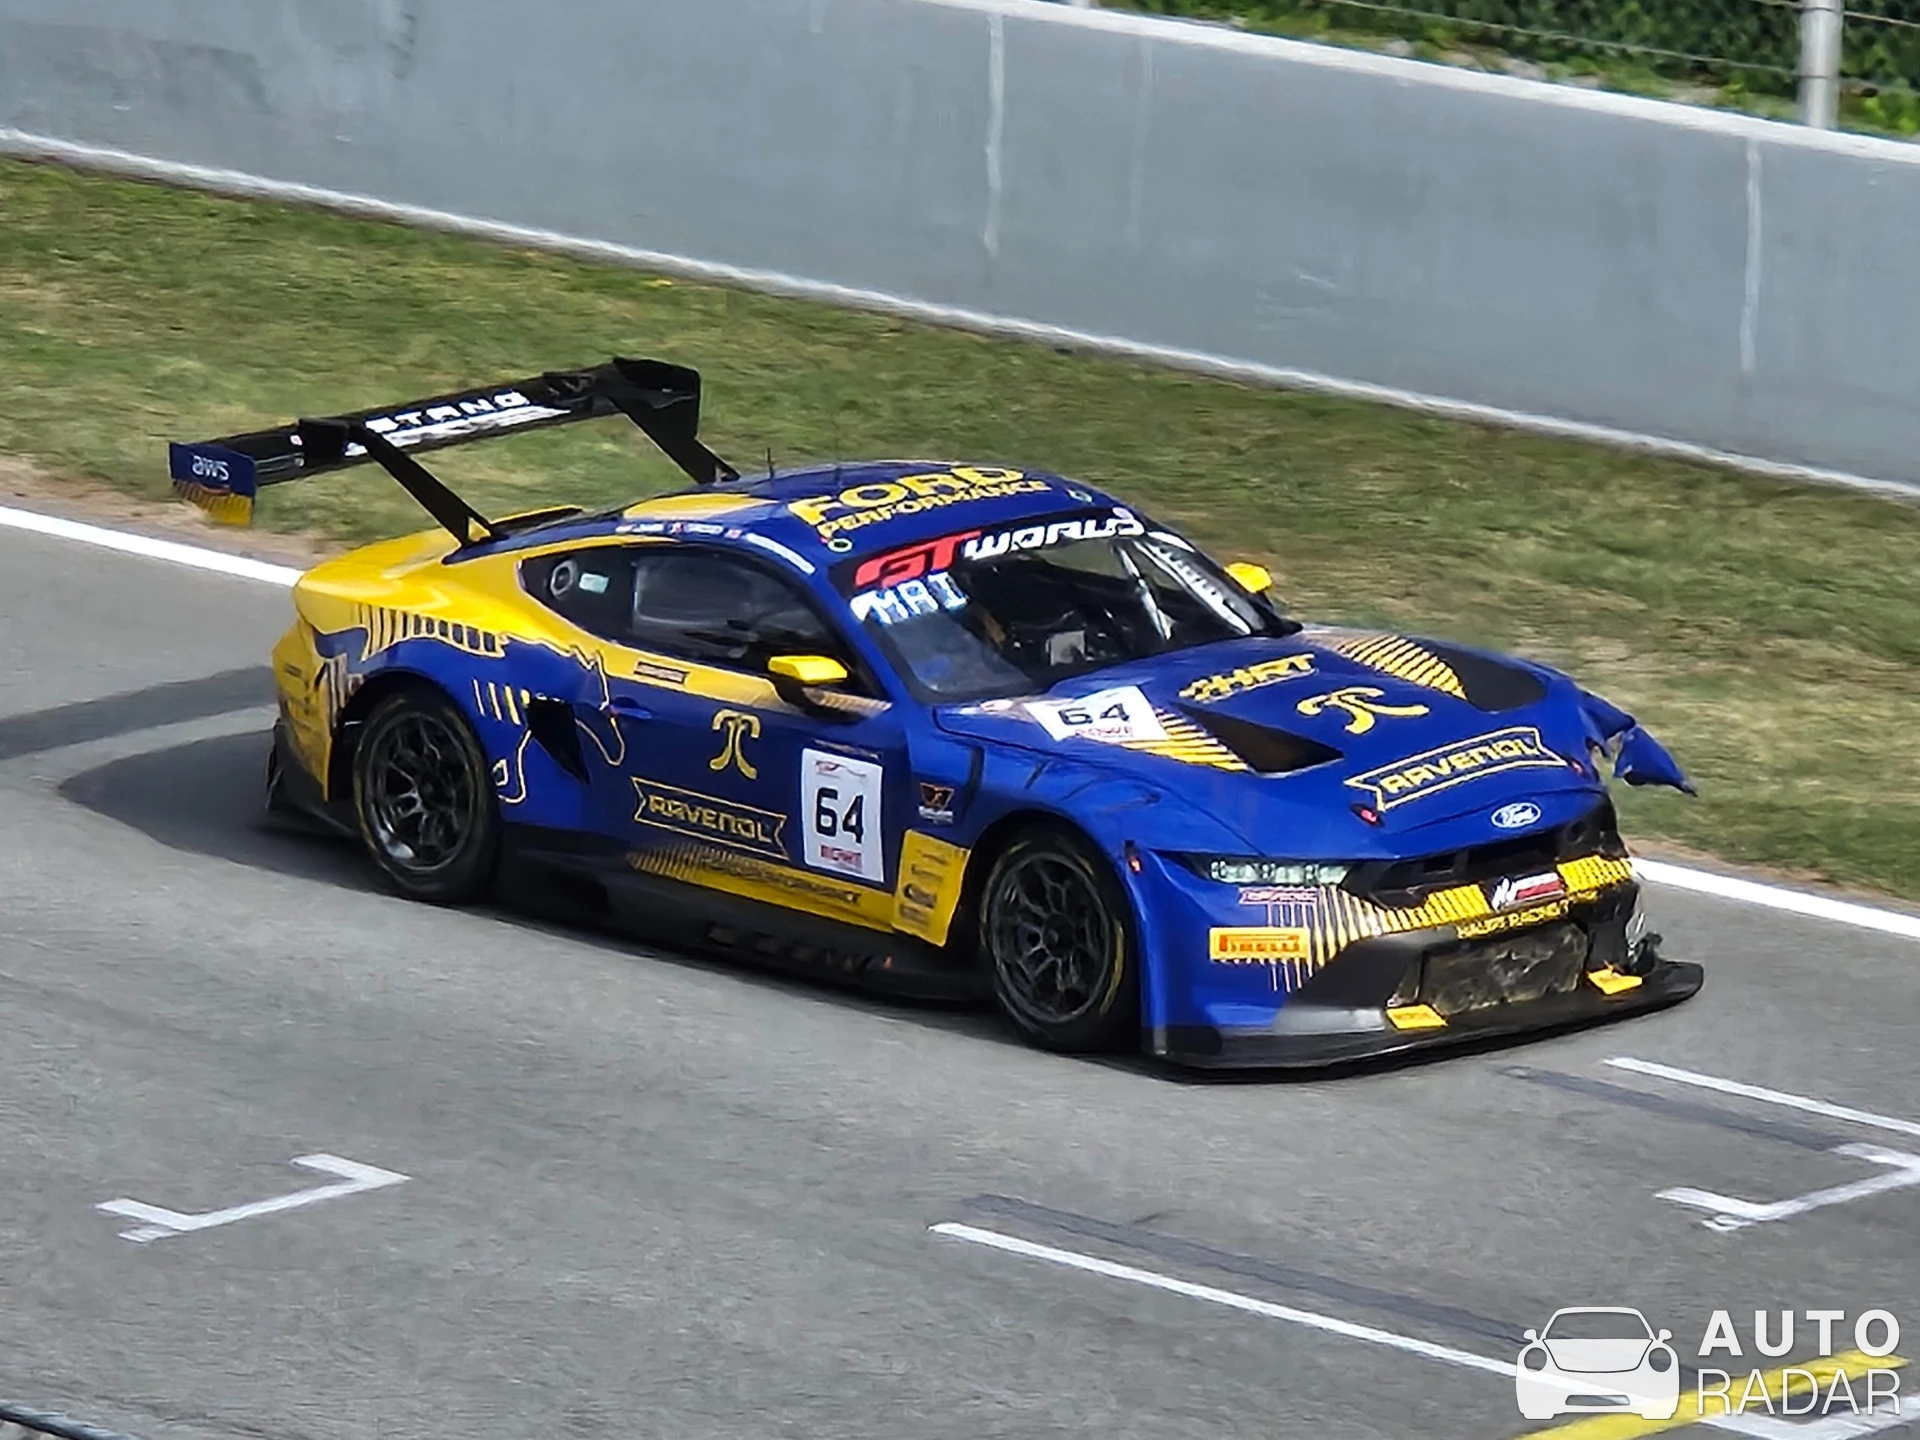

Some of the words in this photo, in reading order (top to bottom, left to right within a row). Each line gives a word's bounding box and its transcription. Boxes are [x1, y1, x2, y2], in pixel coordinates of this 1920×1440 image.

[788, 467, 1024, 525] FORD
[817, 480, 1052, 541] PERFORMANCE
[855, 529, 981, 588] GT
[1058, 702, 1130, 725] 64
[1380, 738, 1540, 793] RAVENOL
[649, 795, 772, 843] RAVENOL
[816, 787, 863, 844] 64
